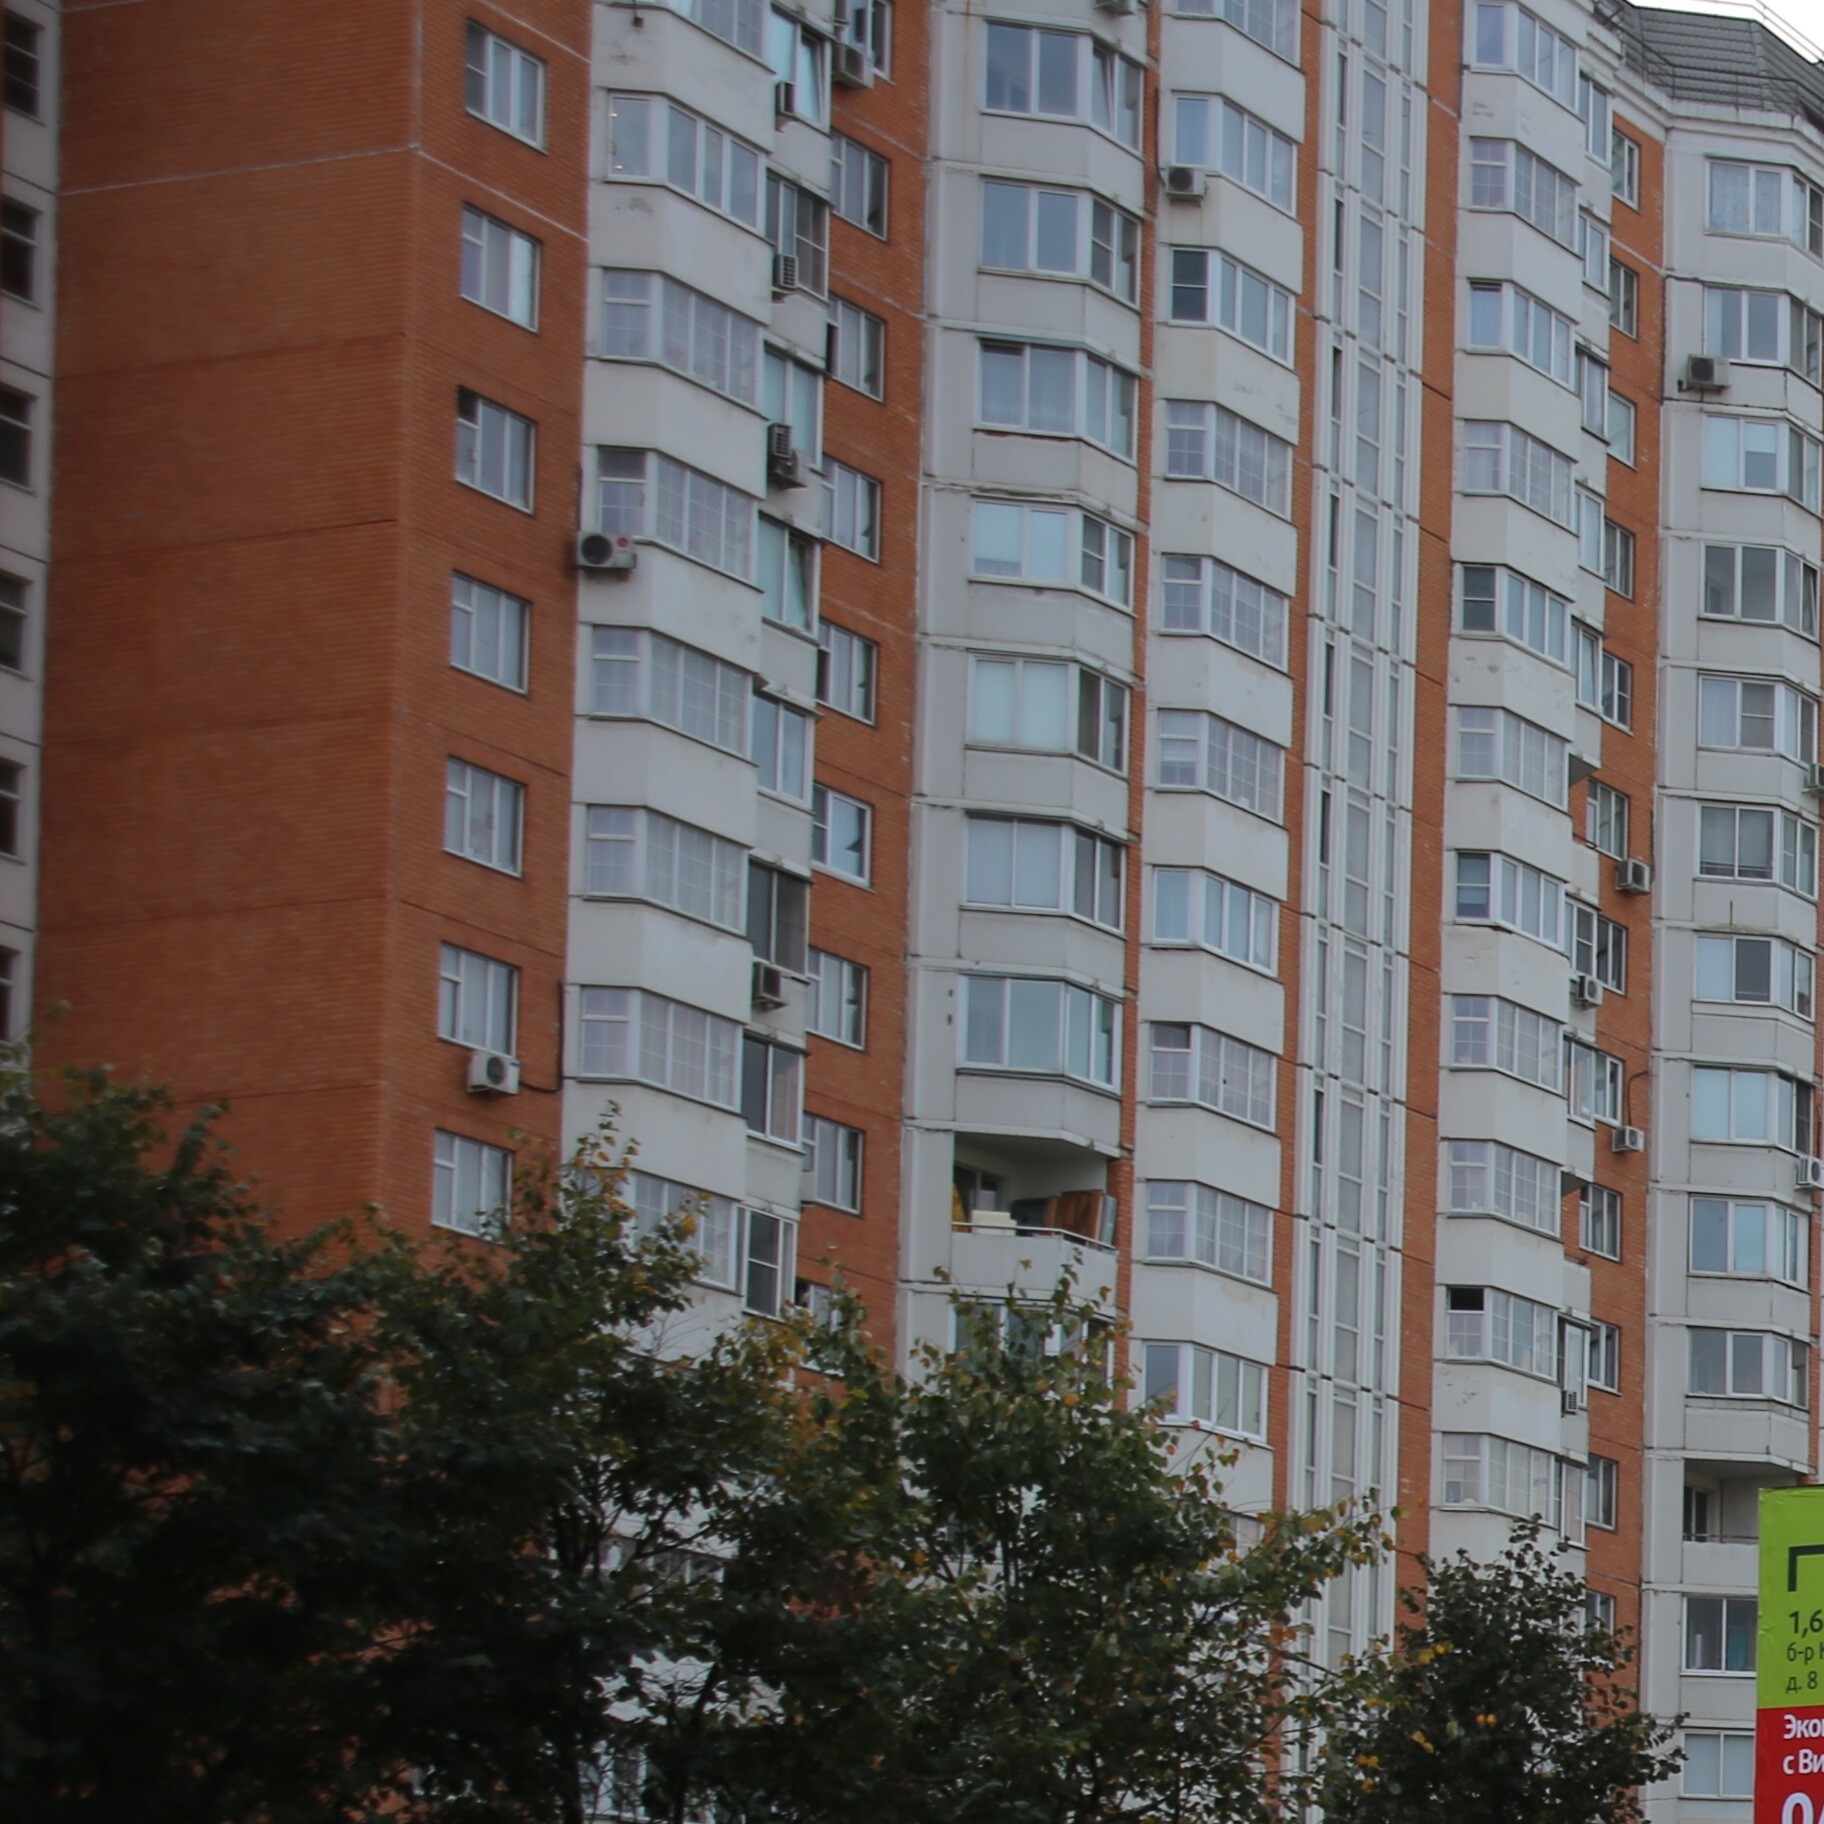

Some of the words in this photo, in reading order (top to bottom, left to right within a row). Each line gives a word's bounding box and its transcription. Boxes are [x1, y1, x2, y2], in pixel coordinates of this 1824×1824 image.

[1788, 1609, 1824, 1638] 1,6
[1786, 1641, 1815, 1666] б-р
[1785, 1676, 1802, 1694] д.
[1807, 1670, 1818, 1690] 8
[1782, 1755, 1795, 1775] с
